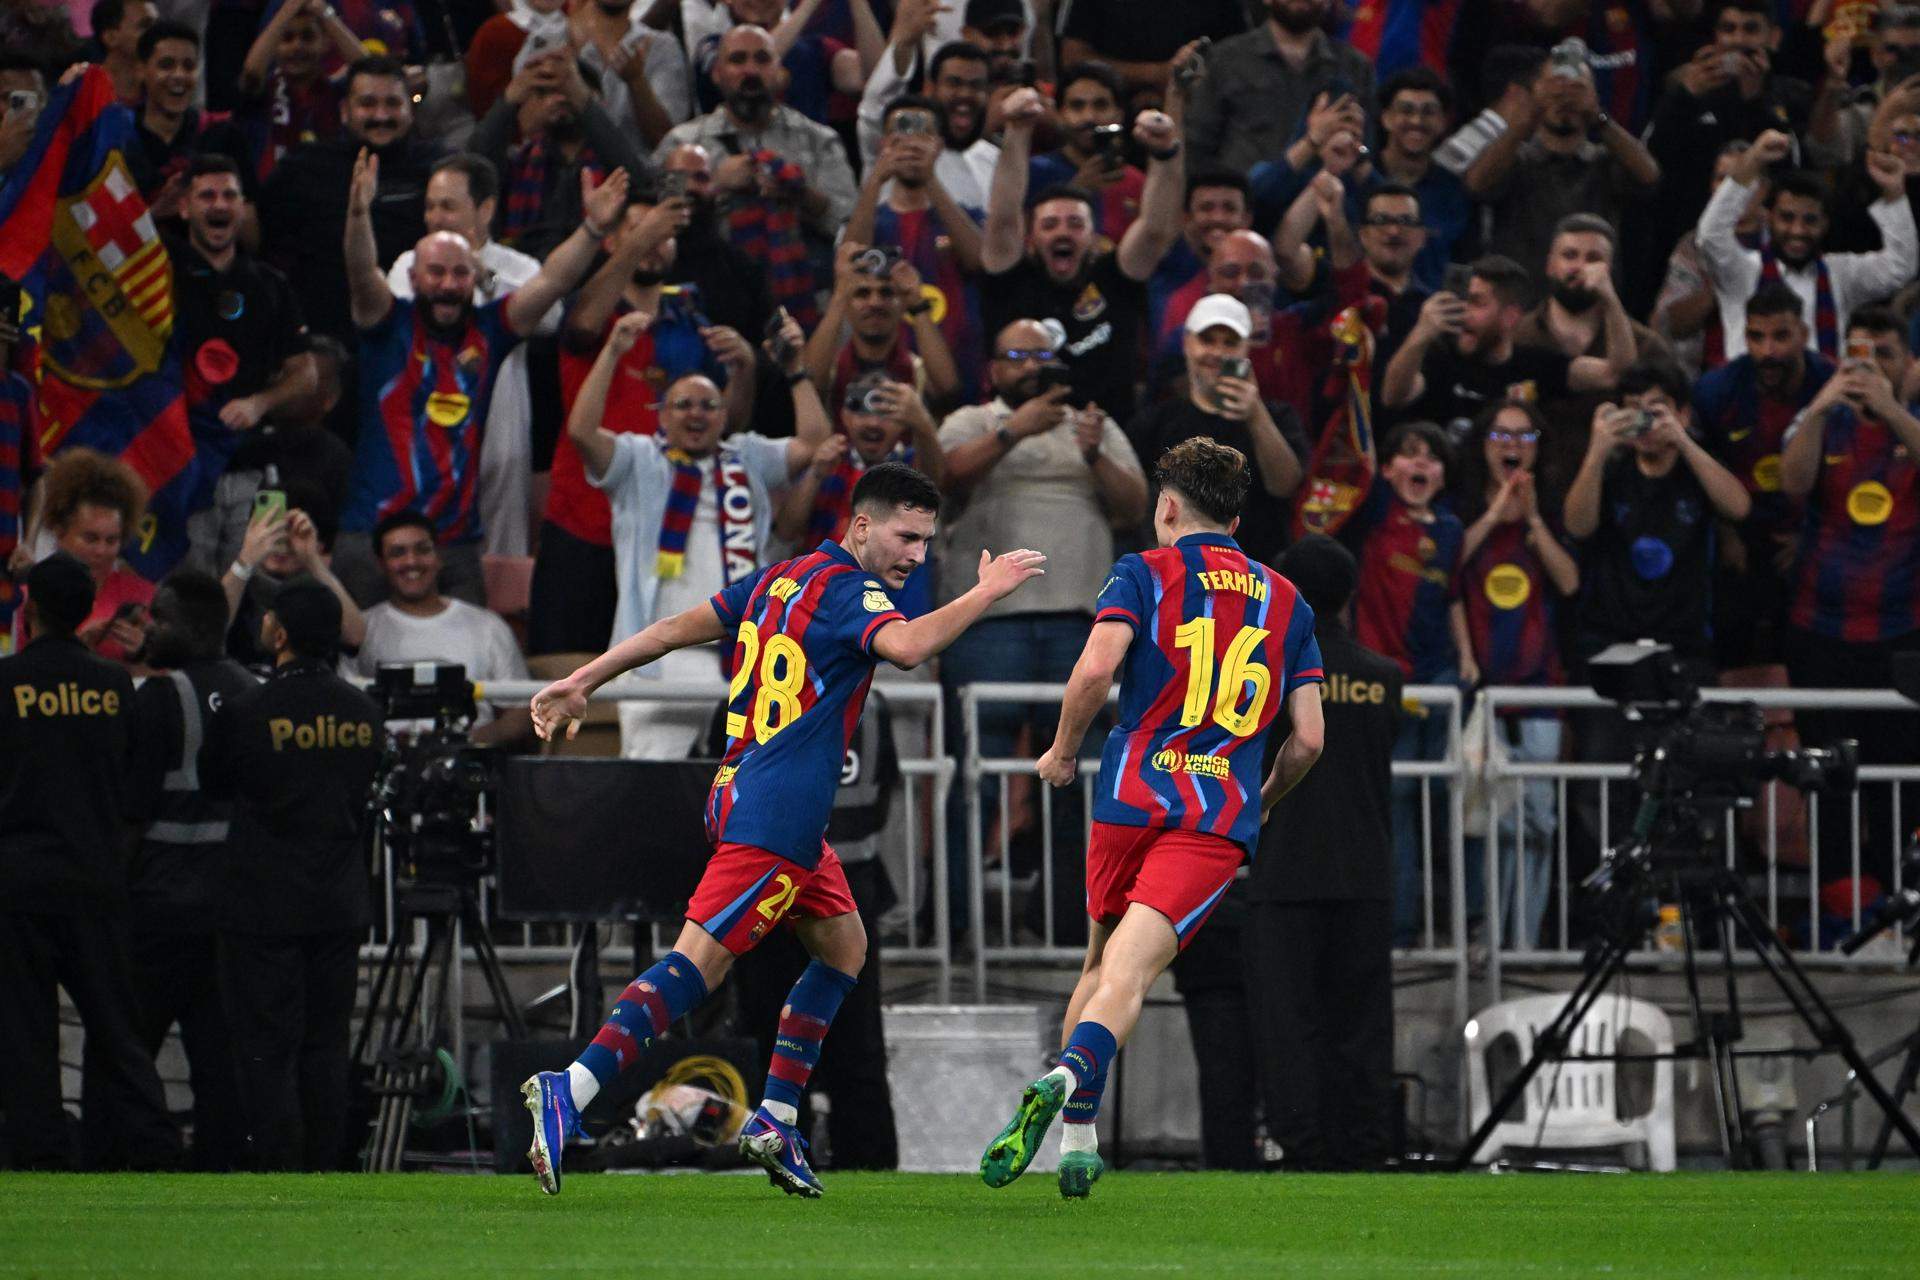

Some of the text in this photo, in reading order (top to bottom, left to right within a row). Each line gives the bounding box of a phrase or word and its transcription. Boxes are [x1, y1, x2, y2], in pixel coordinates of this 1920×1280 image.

[726, 620, 807, 746] 28
[1174, 616, 1271, 738] 16
[13, 682, 120, 718] Police
[269, 714, 373, 751] Police
[1183, 762, 1229, 777] ACNUR
[1184, 753, 1230, 769] UNHCR
